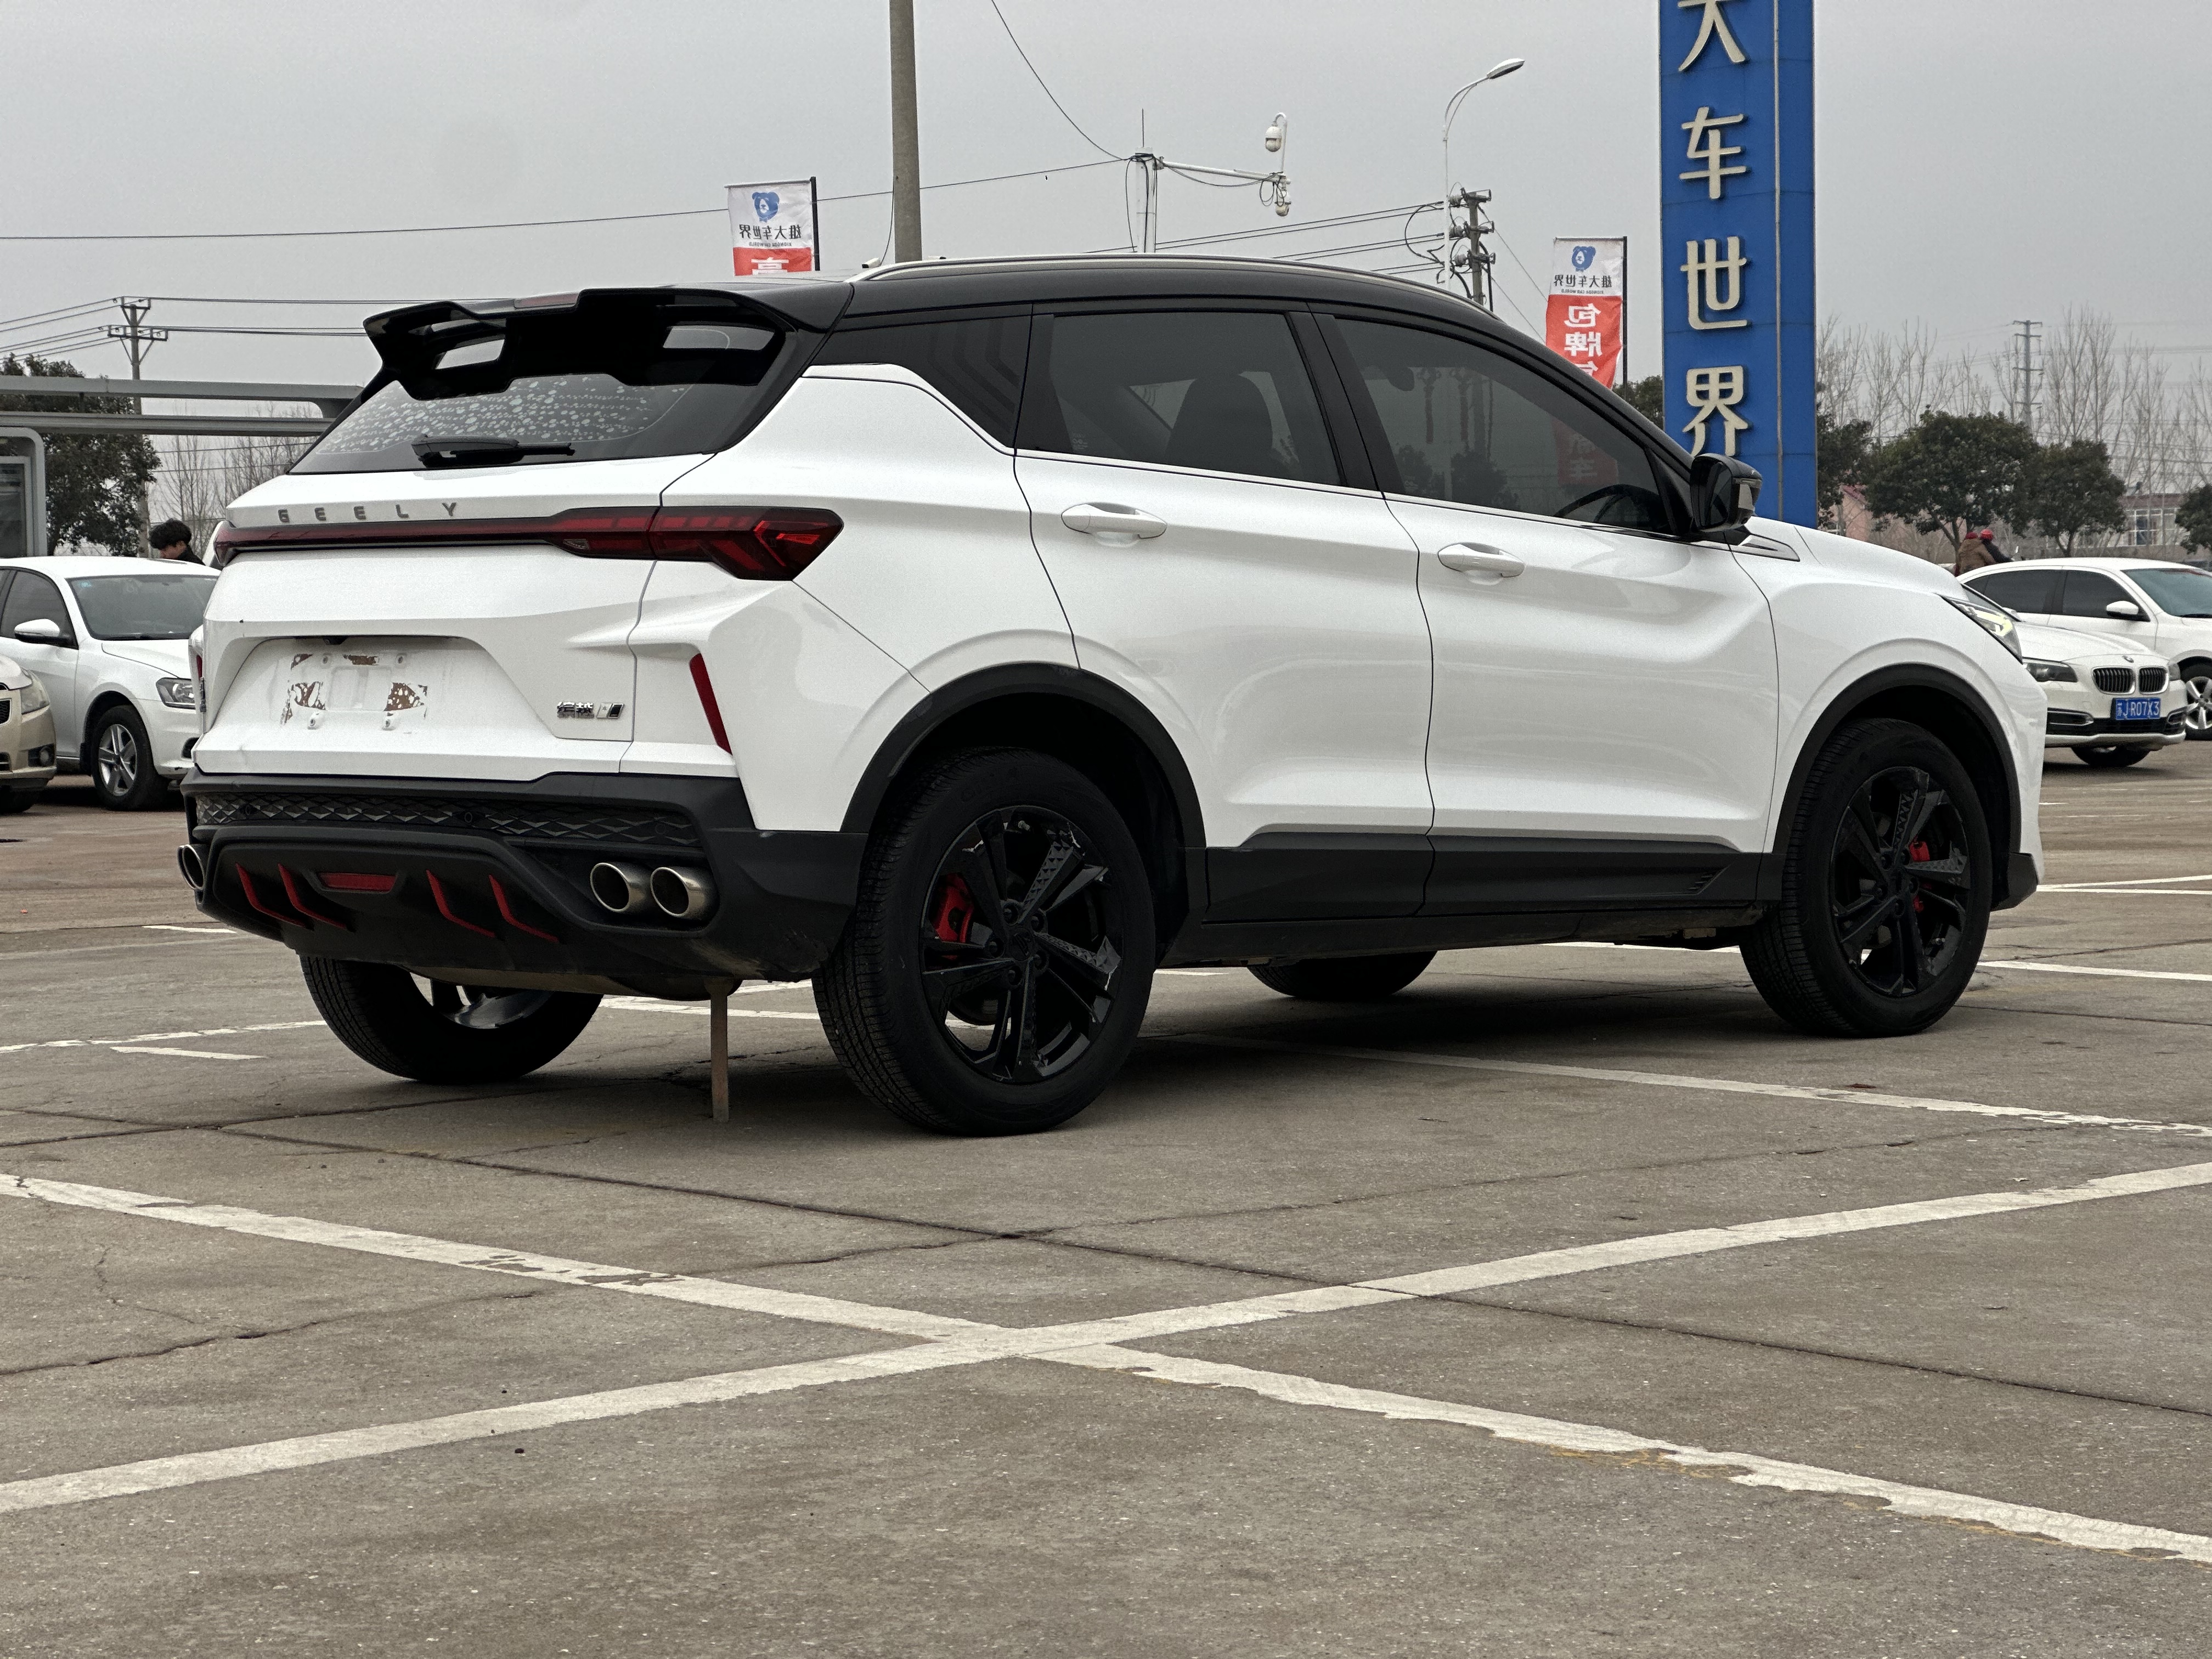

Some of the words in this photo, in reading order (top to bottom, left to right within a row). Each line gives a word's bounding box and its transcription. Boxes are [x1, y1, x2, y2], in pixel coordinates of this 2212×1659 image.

[1678, 0, 1751, 456] 大车世界
[278, 502, 457, 523] GEELY
